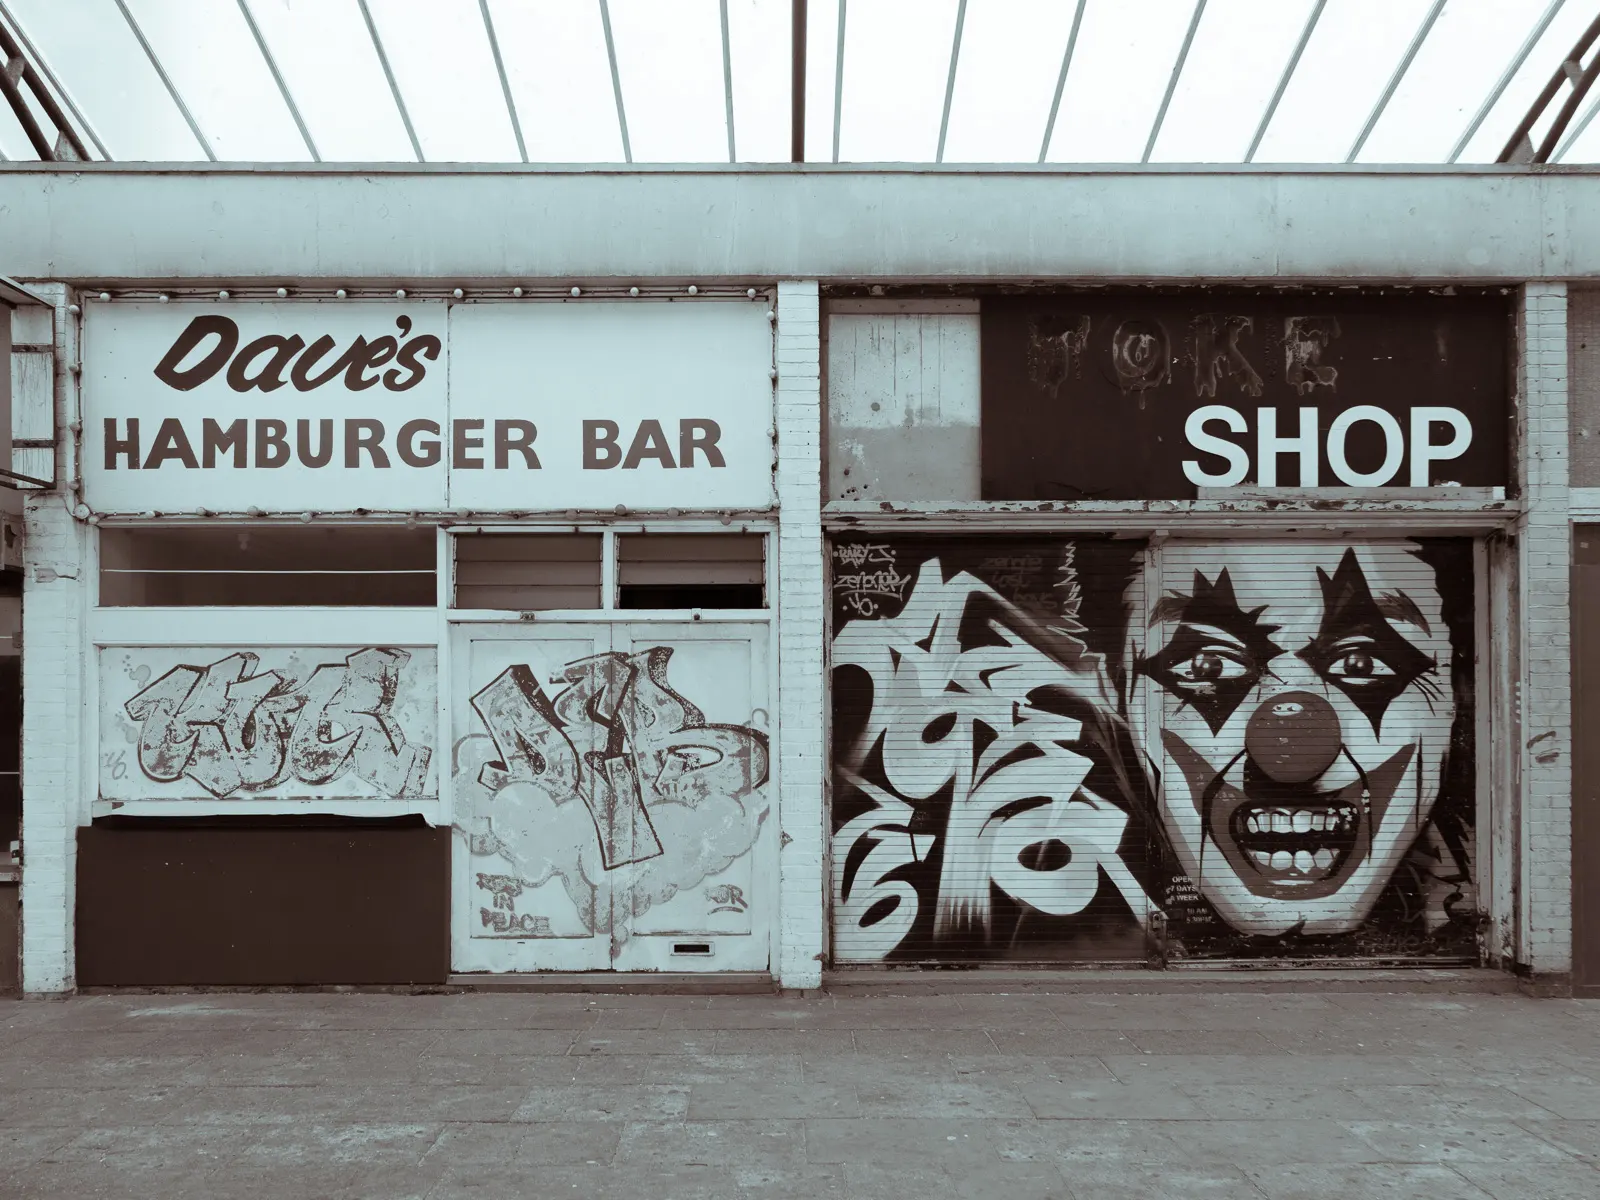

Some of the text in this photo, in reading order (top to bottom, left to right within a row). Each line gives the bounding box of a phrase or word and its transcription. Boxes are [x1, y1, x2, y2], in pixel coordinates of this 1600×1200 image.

[153, 314, 442, 392] Dave's
[103, 418, 727, 470] HAMBURGER BAR
[1181, 404, 1474, 488] SHOP
